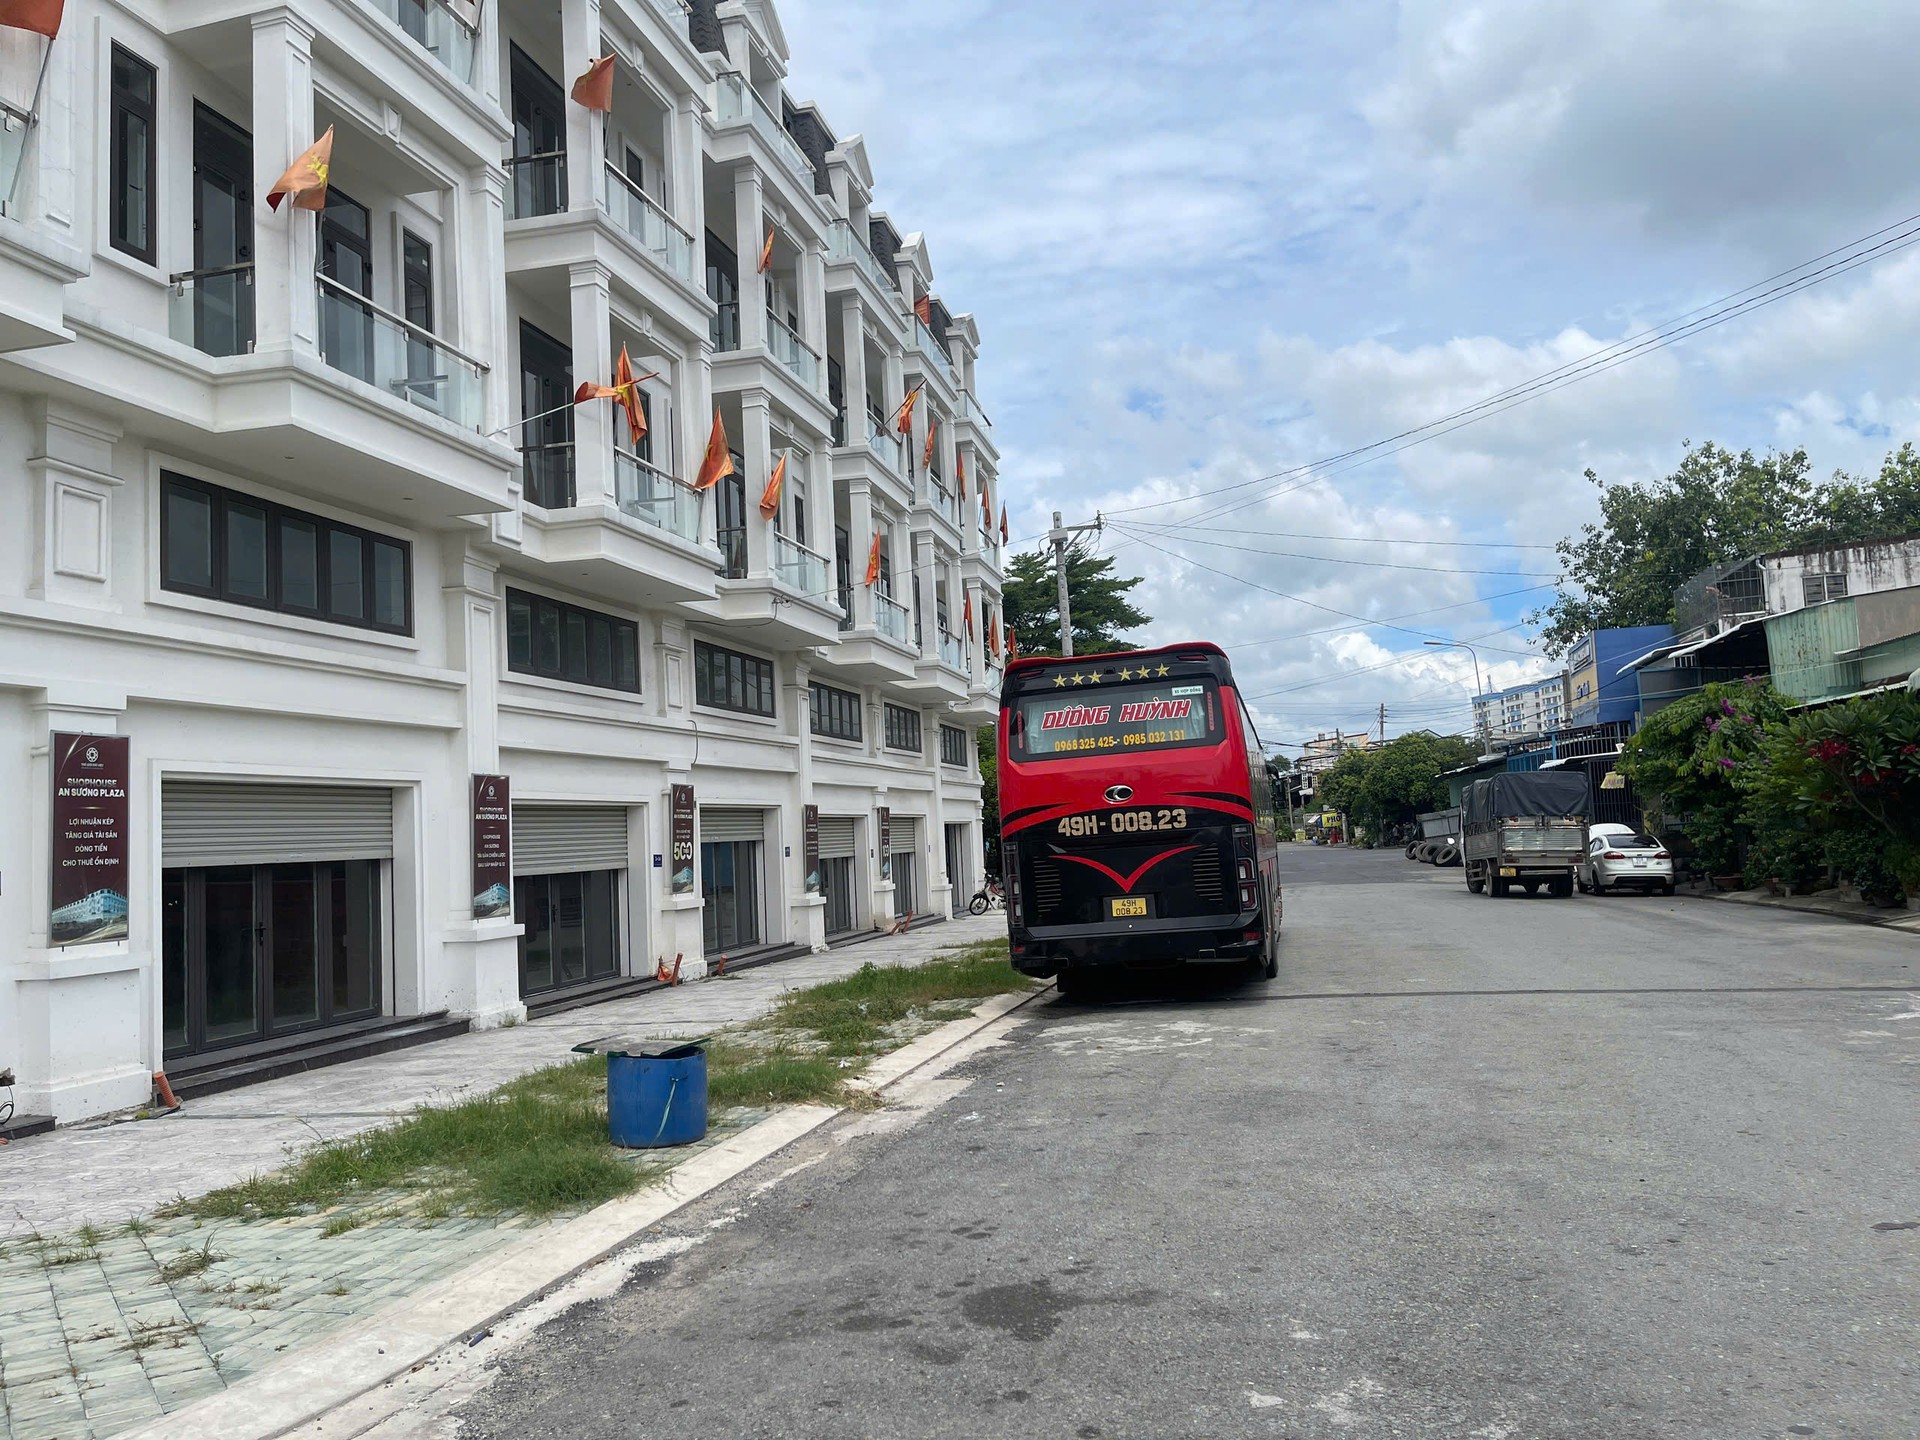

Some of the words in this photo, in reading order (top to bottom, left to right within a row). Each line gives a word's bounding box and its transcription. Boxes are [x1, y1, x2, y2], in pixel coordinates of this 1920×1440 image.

[1119, 697, 1191, 722] HUỲNH
[1055, 740, 1077, 752] 0968
[1079, 738, 1095, 750] 325
[1123, 734, 1146, 746] 0985
[1149, 732, 1166, 743] 032
[1169, 730, 1185, 741] 131
[67, 778, 117, 787] SHOPHOUSE
[58, 788, 70, 796] AN
[71, 787, 99, 797] SƯƠNG
[100, 788, 125, 797] PLAZA
[1121, 899, 1137, 907] 49H
